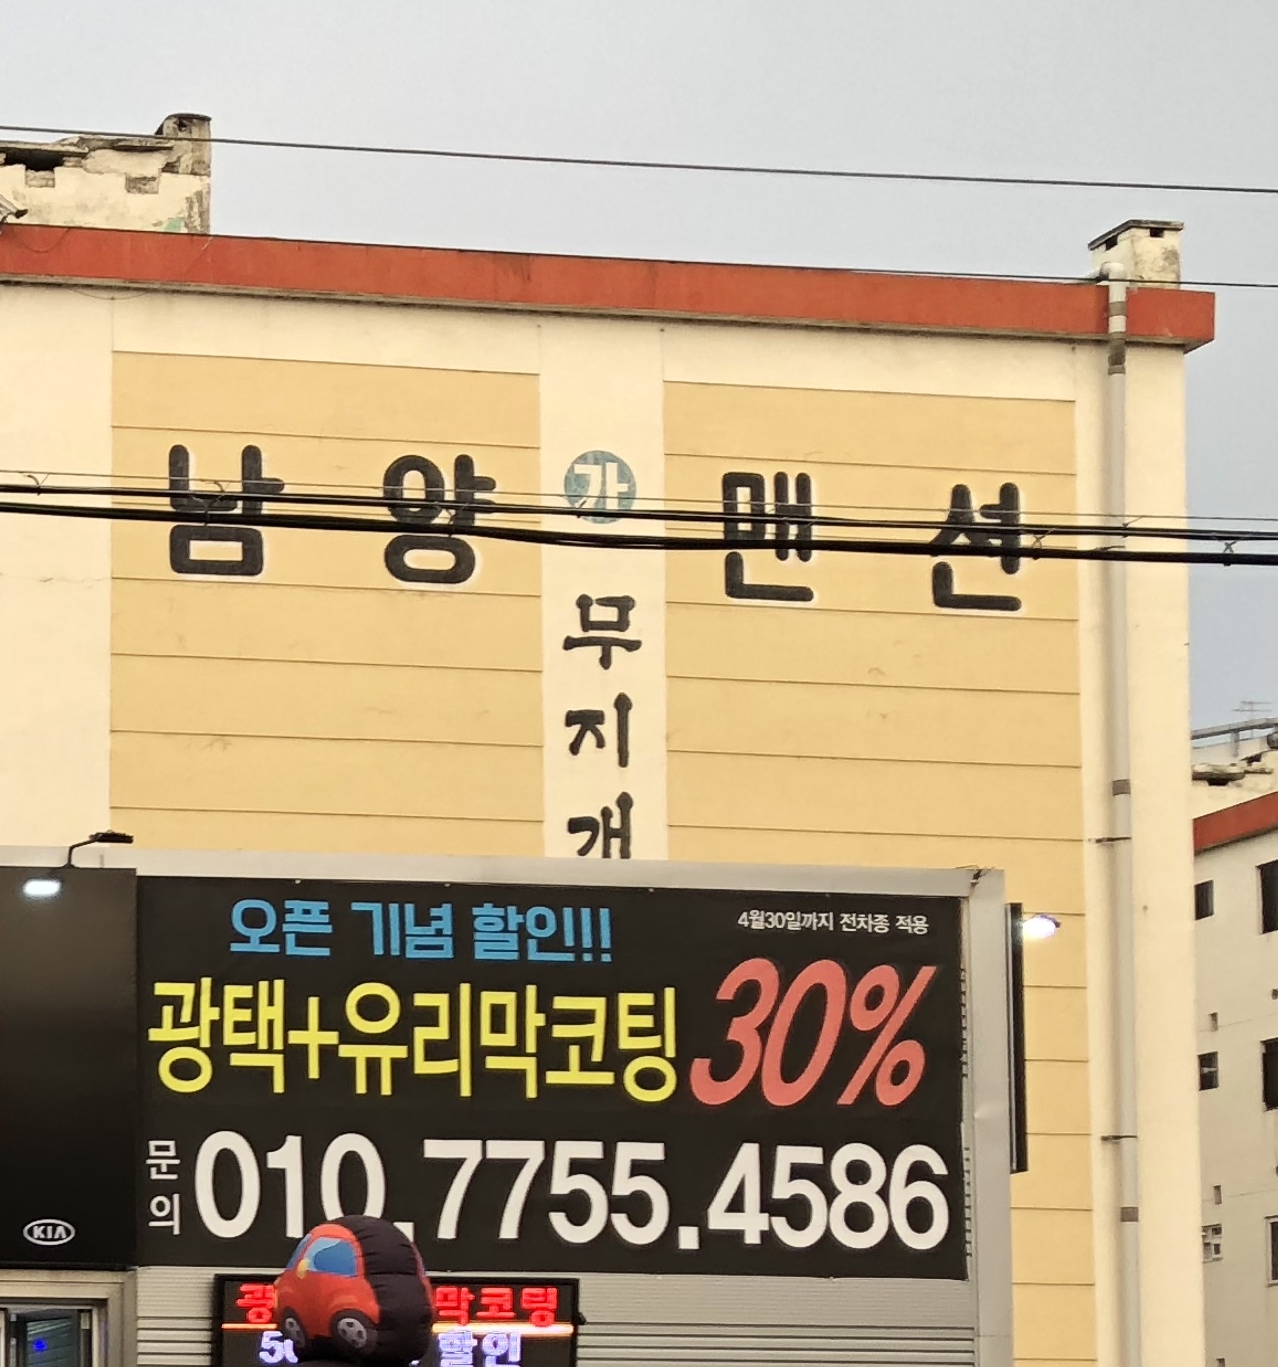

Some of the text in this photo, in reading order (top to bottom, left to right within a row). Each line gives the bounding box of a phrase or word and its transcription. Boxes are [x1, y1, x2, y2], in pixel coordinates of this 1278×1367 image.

[562, 593, 643, 860] 무지개
[228, 898, 614, 964] 오픈 기념 할인!!
[737, 909, 929, 935] 4월30일까지 전차종 적용
[147, 956, 938, 1107] 광택+유리막코팅 30%
[32, 1226, 67, 1239] KIA
[145, 1139, 182, 1237] 문의
[194, 1129, 951, 1251] 010.7755.4586
